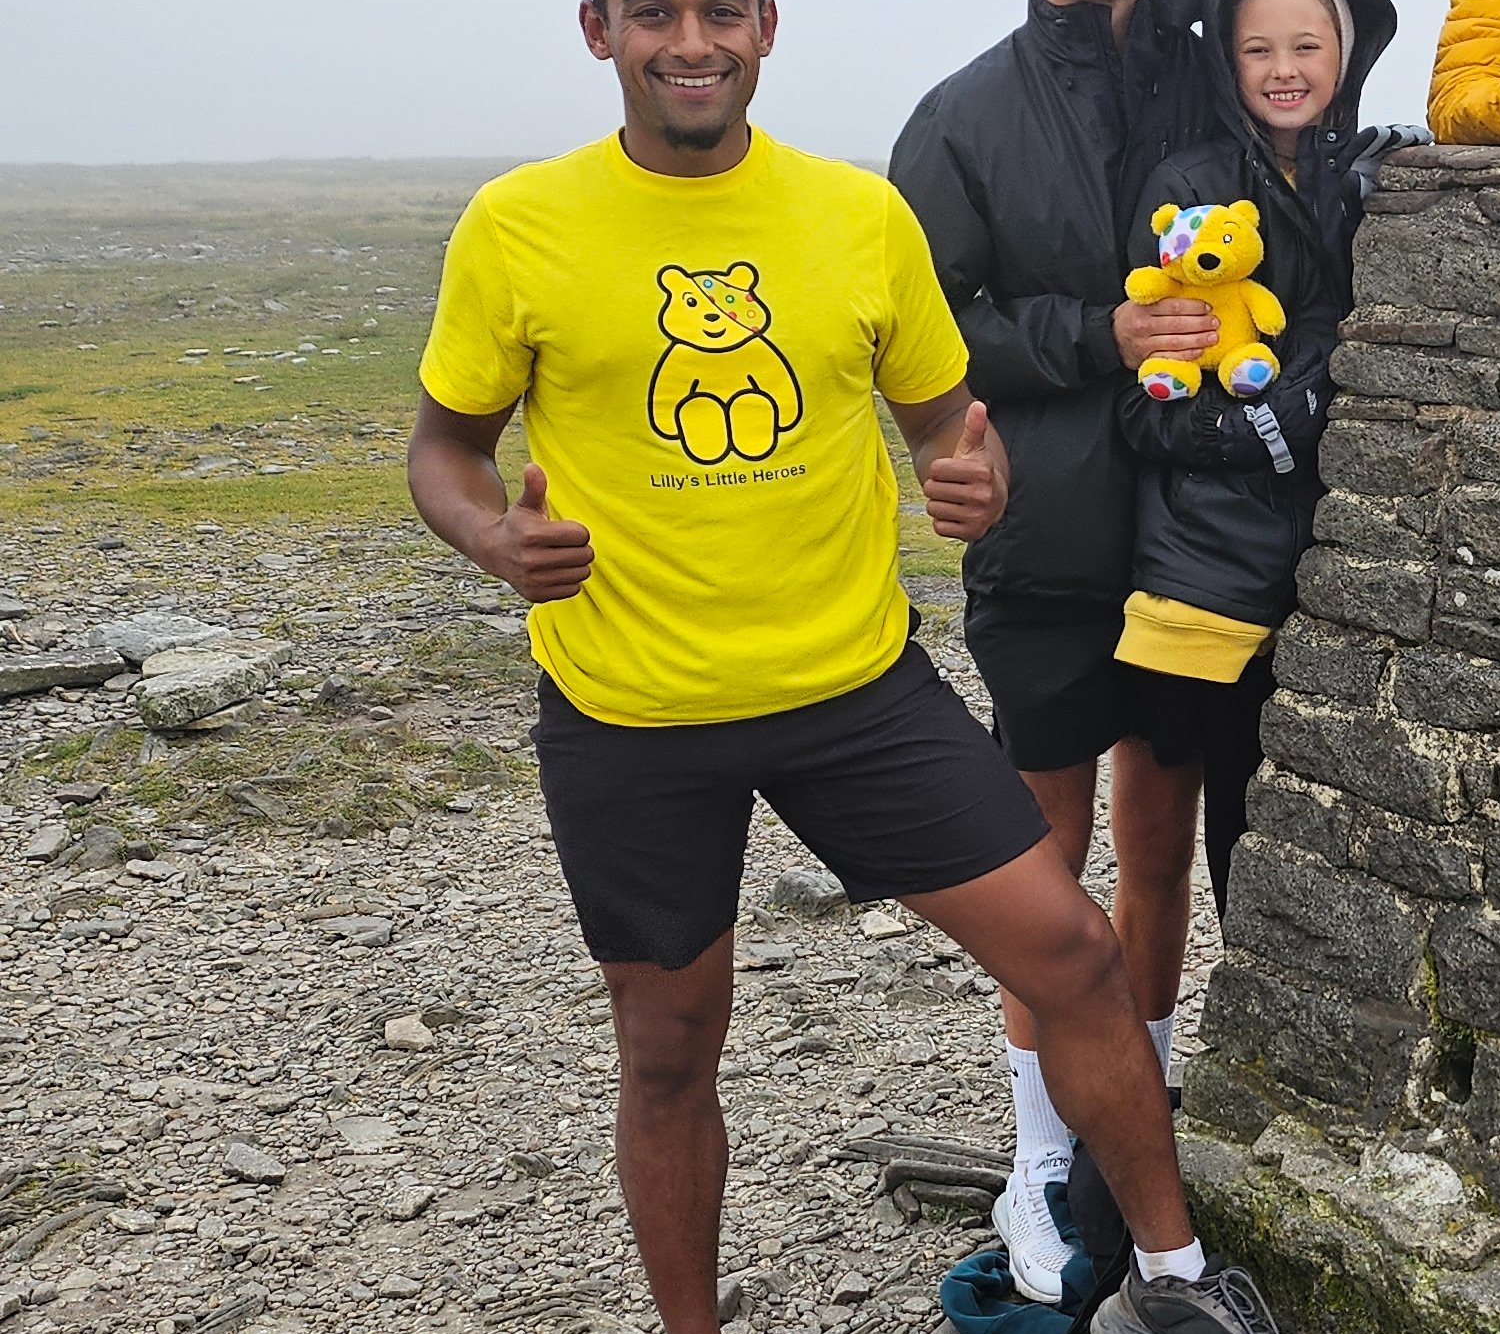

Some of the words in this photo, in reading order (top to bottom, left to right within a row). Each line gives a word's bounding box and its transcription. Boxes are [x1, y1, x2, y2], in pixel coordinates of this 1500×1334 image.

[650, 474, 700, 490] Lilly's
[705, 471, 747, 486] Little
[753, 464, 806, 482] Heroes
